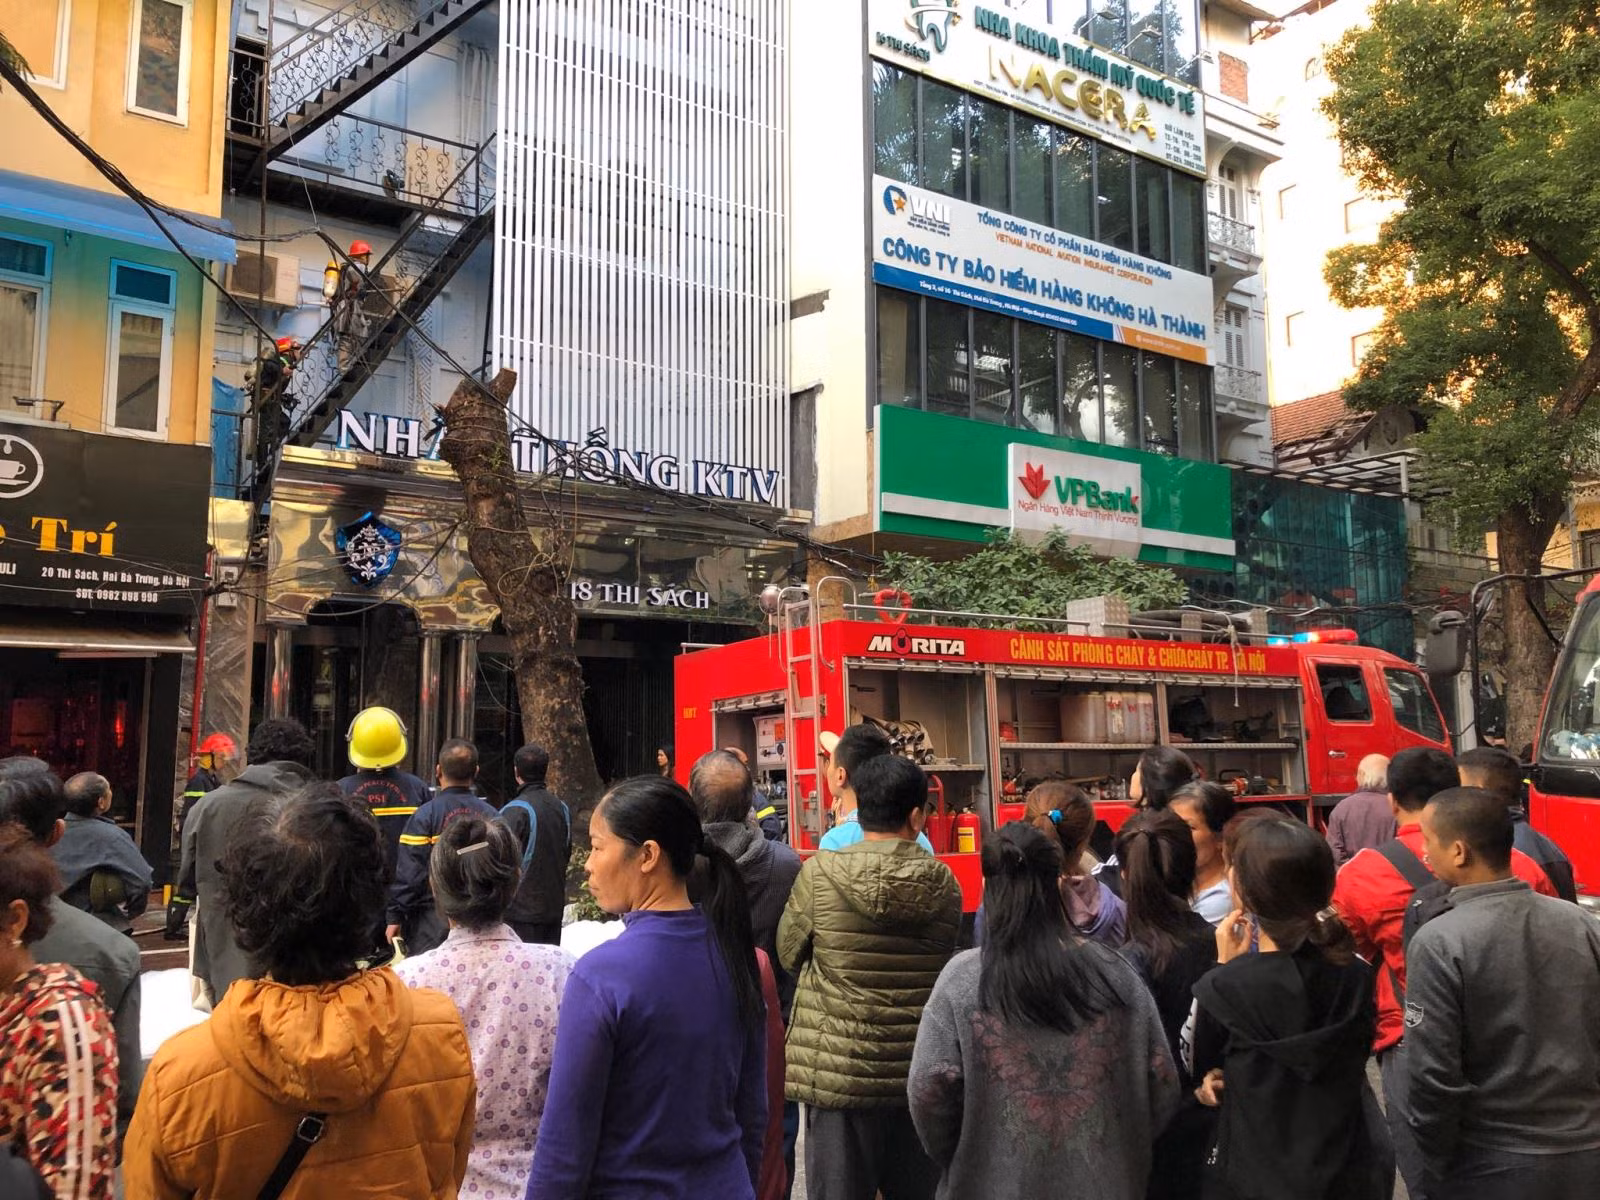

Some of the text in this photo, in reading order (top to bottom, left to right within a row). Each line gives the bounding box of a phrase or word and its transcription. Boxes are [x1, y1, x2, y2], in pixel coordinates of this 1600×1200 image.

[975, 6, 1012, 41] NHA
[1015, 22, 1060, 61] KHOA
[910, 194, 951, 225] VNI
[1003, 221, 1028, 237] CÔNG
[1030, 228, 1042, 241] TY
[883, 237, 931, 266] CÔNG
[936, 251, 959, 274] TY
[963, 257, 996, 284] BẢO
[1000, 267, 1037, 296] HIỂM
[1041, 278, 1084, 307] HÀNG
[1087, 293, 1136, 322] KHÔNG
[1138, 306, 1159, 328] HÀ
[1161, 313, 1207, 341] THÀNH
[692, 460, 780, 504] KTV
[1054, 475, 1139, 514] VPBank
[1018, 499, 1038, 512] Ngân
[1040, 503, 1059, 516] Hàng
[1061, 504, 1075, 517] Việt
[1075, 507, 1093, 518] Nam
[31, 516, 118, 557] Trí
[41, 566, 54, 578] 20
[57, 567, 71, 579] Thi
[103, 571, 118, 582] Hai
[121, 572, 132, 583] Bà
[163, 575, 173, 586] Hà
[571, 581, 709, 609] 18 THI SÁCH
[867, 628, 965, 656] MORITA
[1010, 634, 1044, 660] CẢNH
[1047, 637, 1069, 662] SÁT
[1072, 638, 1114, 664] PHÒNG
[1115, 641, 1144, 666] CHÁY
[1147, 647, 1157, 666] &
[1215, 650, 1229, 670] TP.
[1248, 649, 1266, 675] NỘI
